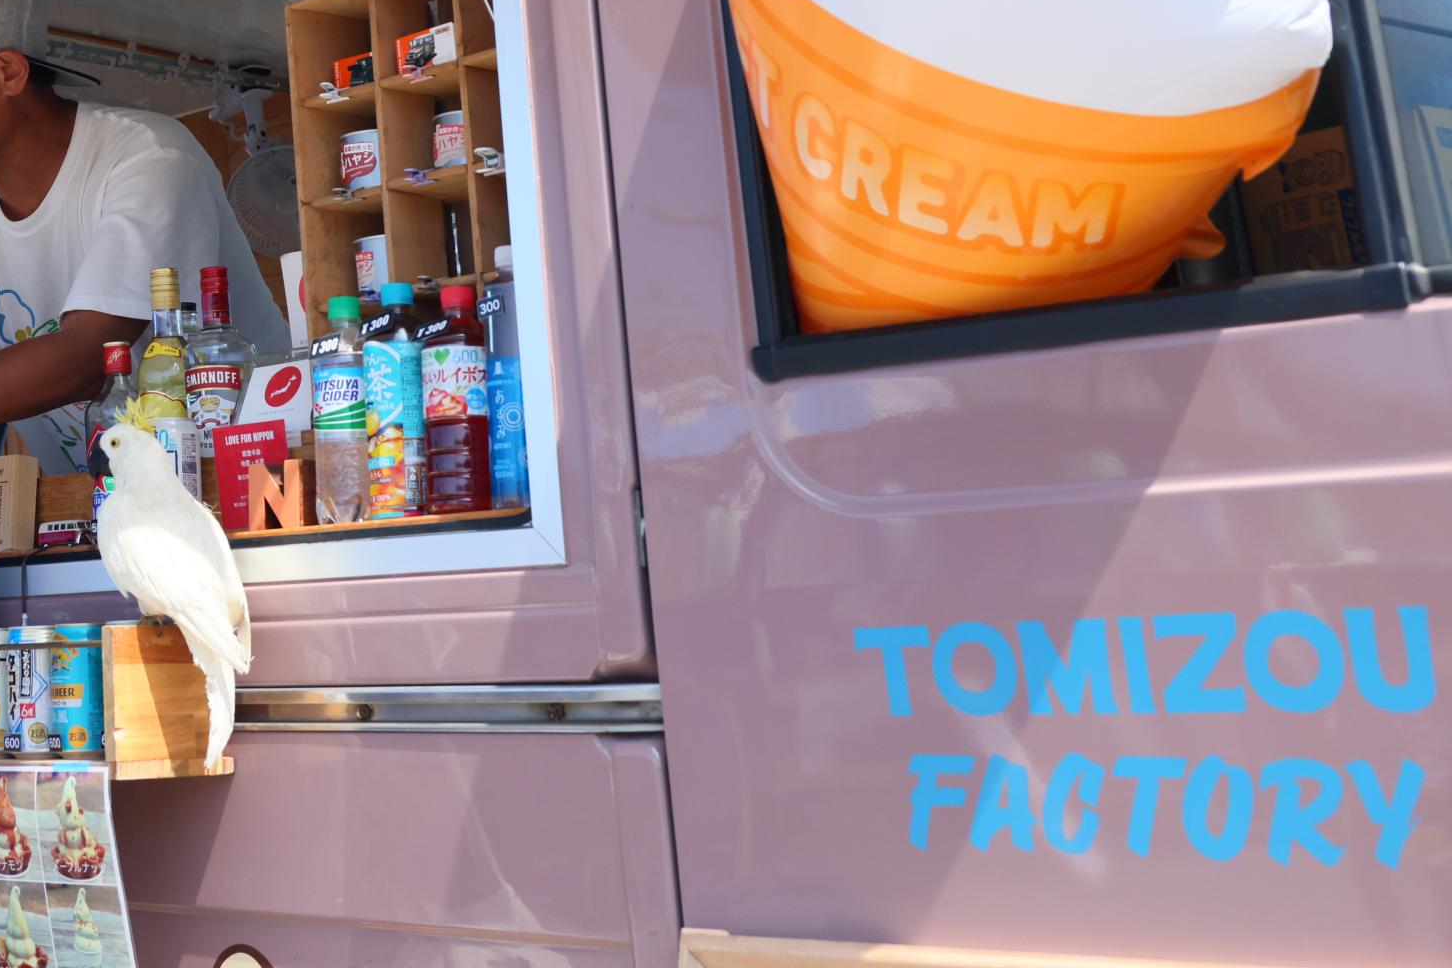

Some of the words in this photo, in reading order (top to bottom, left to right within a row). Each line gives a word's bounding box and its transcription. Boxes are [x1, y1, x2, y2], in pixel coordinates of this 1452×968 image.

[794, 93, 1118, 249] CREAM
[480, 299, 500, 315] 300
[323, 390, 359, 402] CIDER
[853, 606, 1437, 716] TOMIZOU
[4, 736, 20, 749] 600
[908, 752, 1426, 871] FACTORY
